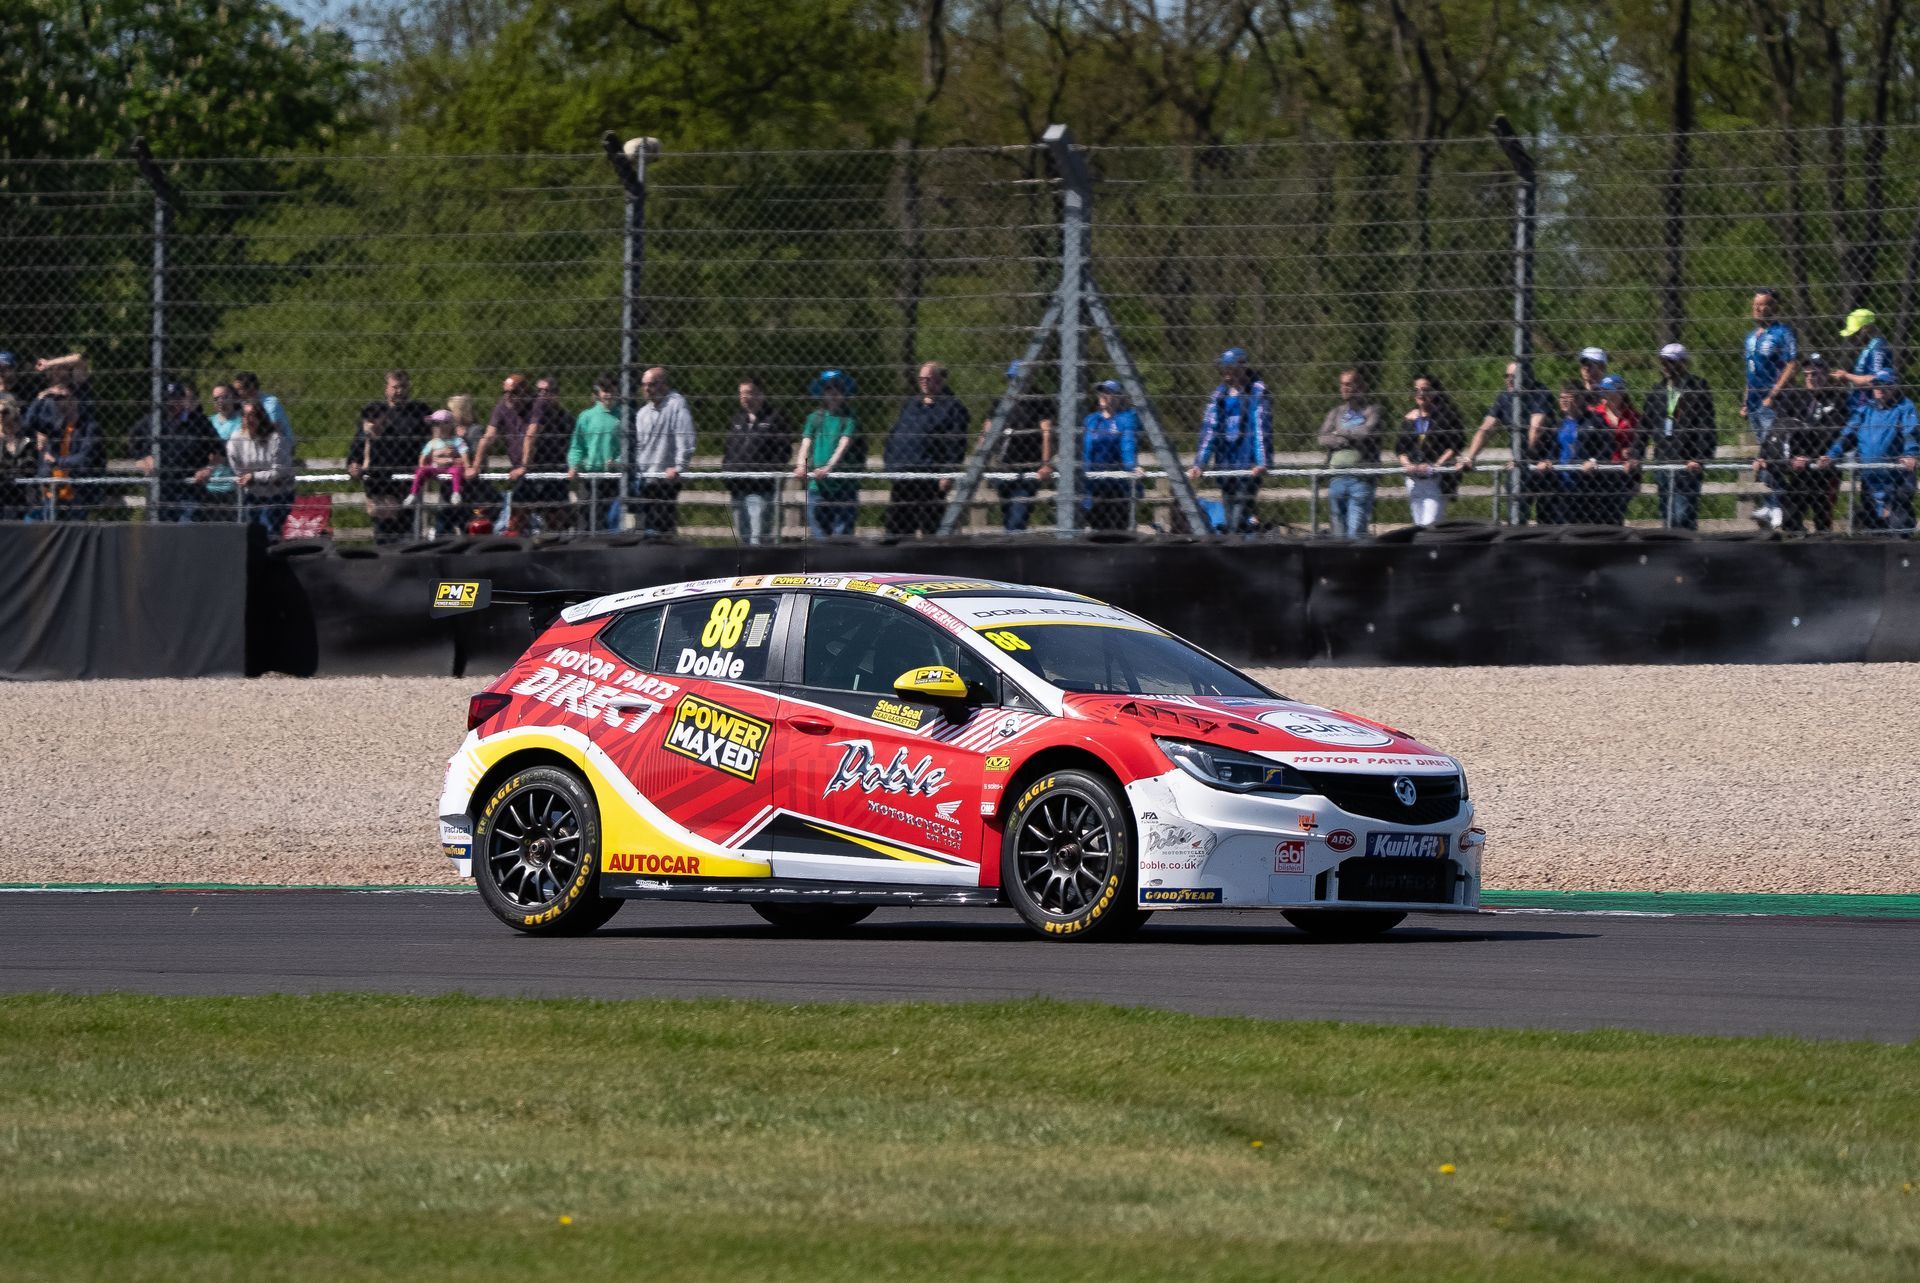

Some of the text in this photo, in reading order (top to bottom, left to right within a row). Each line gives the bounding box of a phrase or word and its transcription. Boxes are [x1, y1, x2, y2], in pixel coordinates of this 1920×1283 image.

[438, 585, 476, 599] PMR
[774, 576, 840, 587] POWER MAXED
[702, 597, 750, 649] 88
[985, 631, 1031, 651] 88
[545, 647, 680, 700] MOTOR PARTS
[675, 648, 746, 680] Doble
[509, 666, 664, 733] DIRECT
[872, 710, 918, 727] HEAD GASKET FIX
[875, 700, 923, 721] Steel Seal
[679, 700, 762, 751] POWER
[670, 721, 754, 772] MAXED
[821, 738, 953, 800] Doble
[1294, 756, 1454, 768] MOTOR PARTS DIRECT
[485, 776, 520, 817] EAGLE
[1017, 777, 1056, 812] EAGLE
[868, 800, 963, 841] MOTORCYCLES
[935, 813, 960, 825] HONDA
[1141, 812, 1159, 820] JFA
[1331, 835, 1354, 846] ABS
[1275, 841, 1305, 864] febi
[608, 853, 700, 874] AUTOCAR
[1140, 861, 1197, 870] Doble.co.uk
[1145, 889, 1216, 901] GOODYEAR
